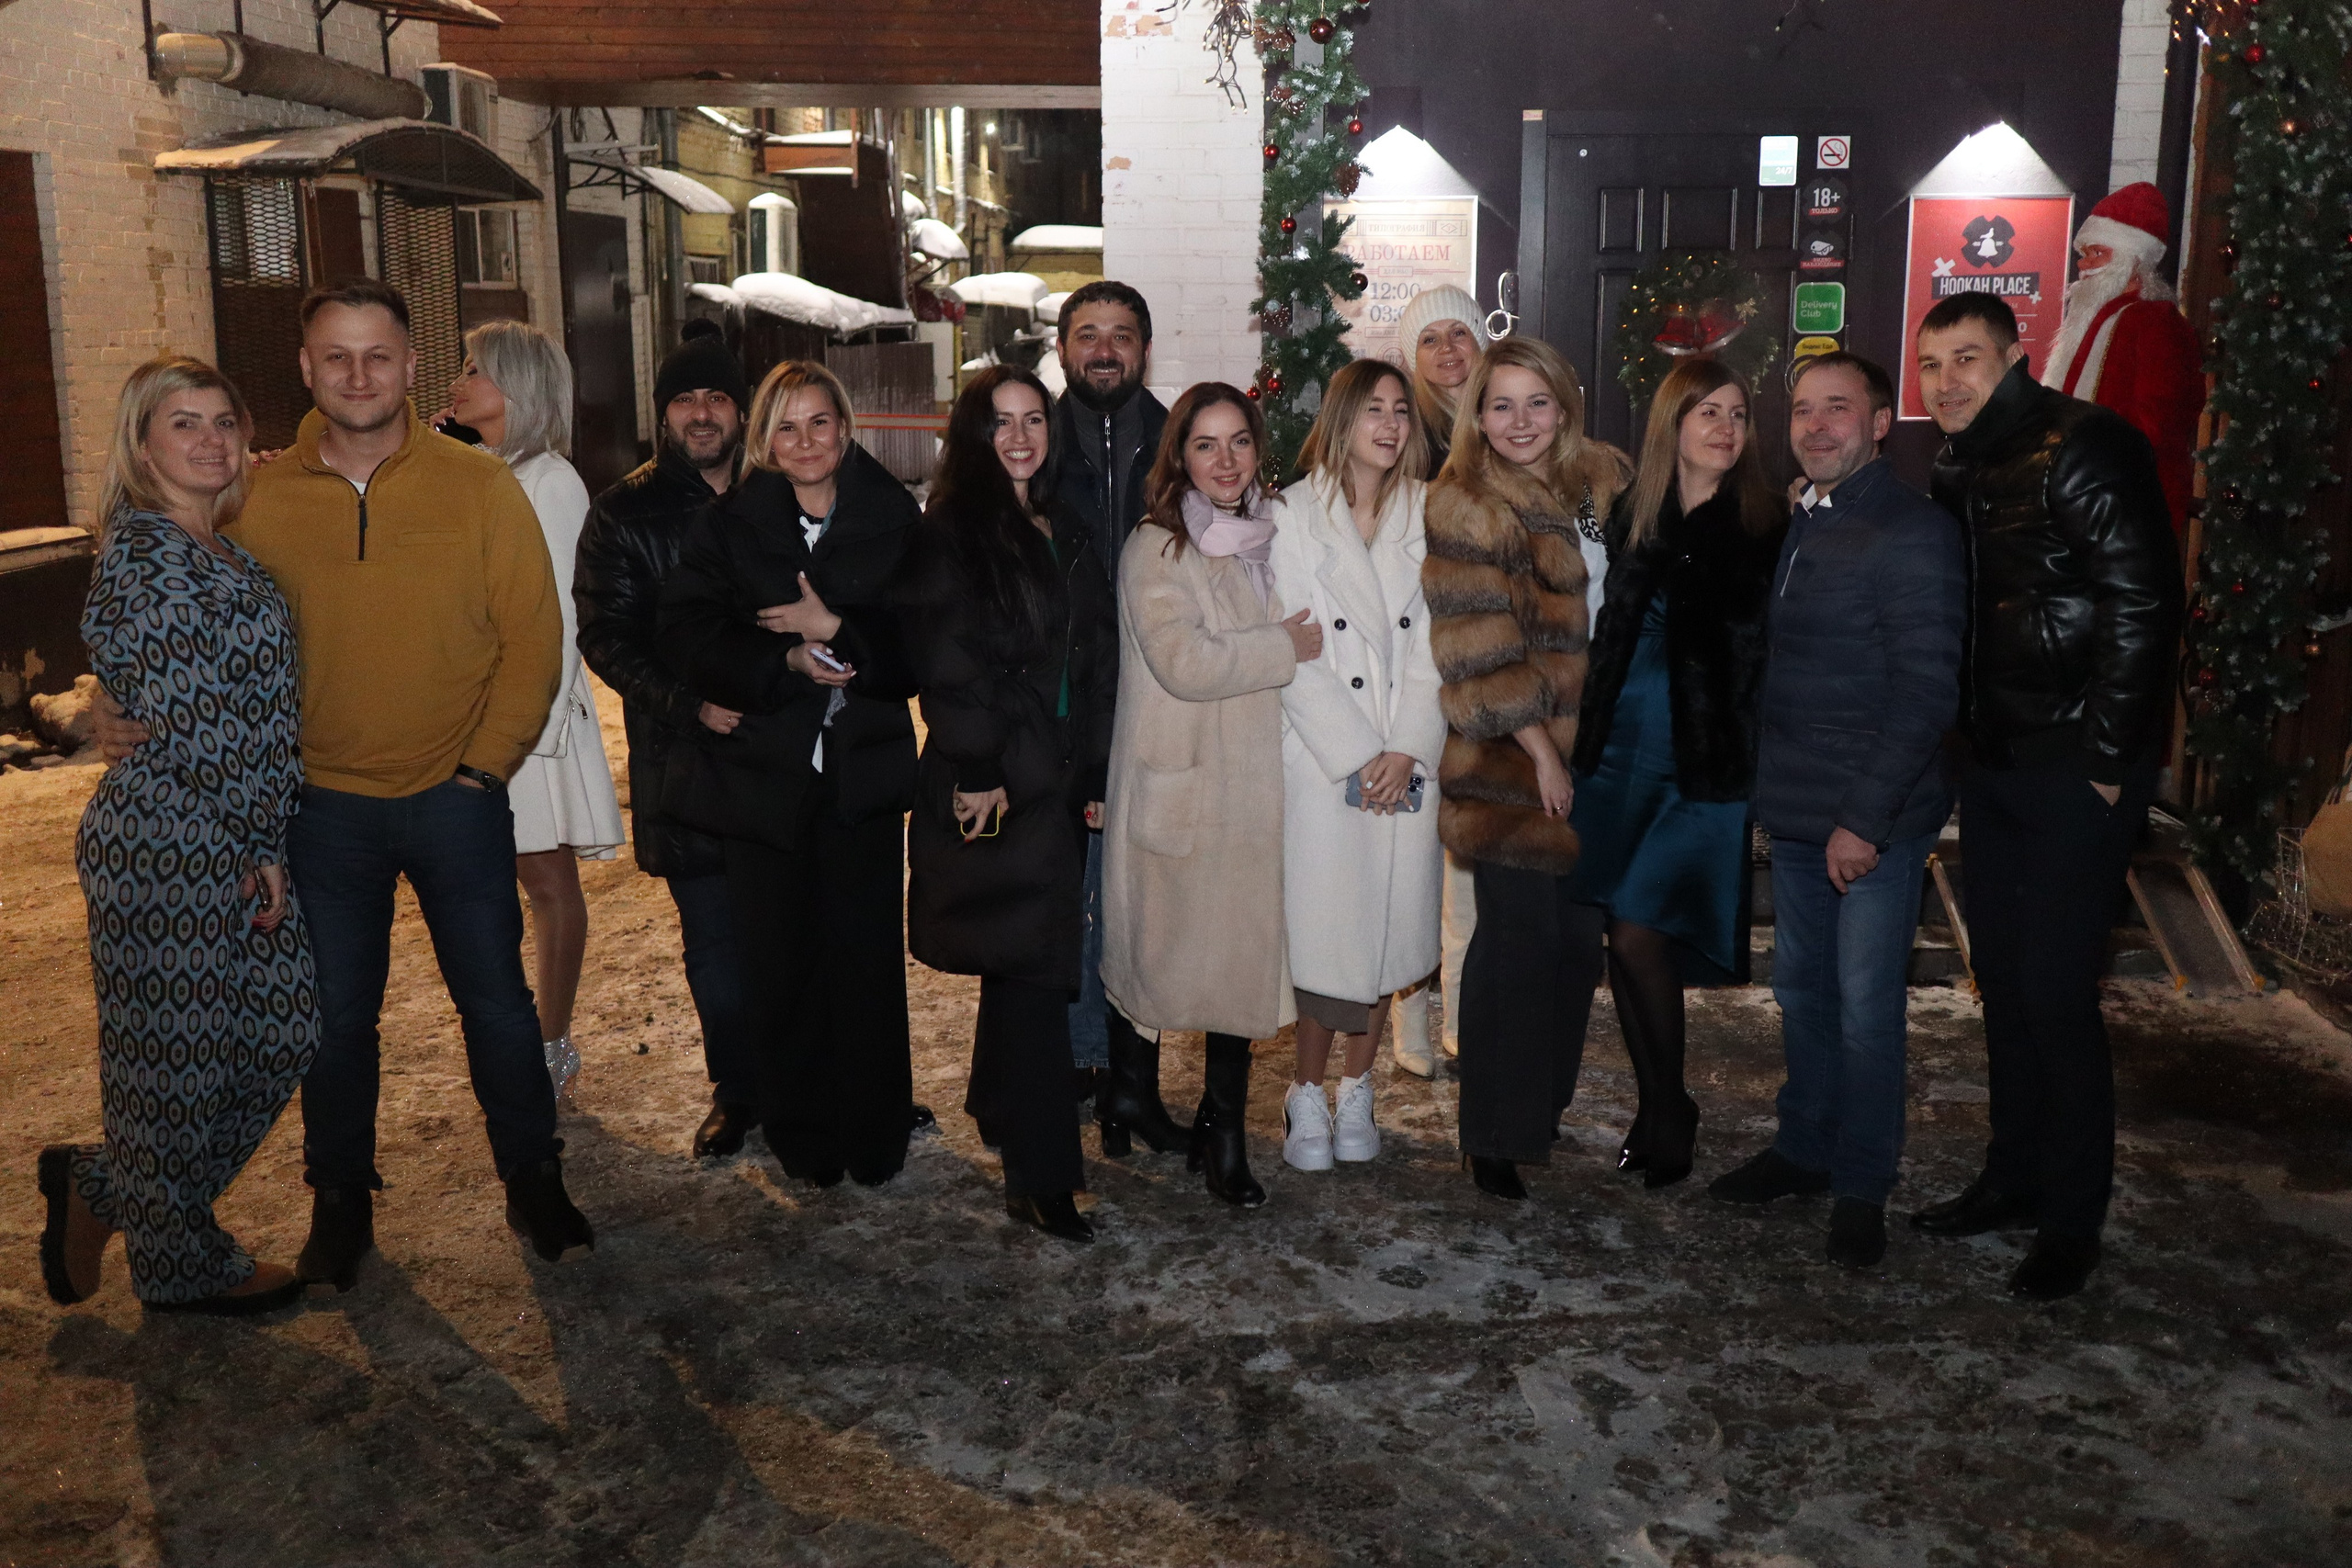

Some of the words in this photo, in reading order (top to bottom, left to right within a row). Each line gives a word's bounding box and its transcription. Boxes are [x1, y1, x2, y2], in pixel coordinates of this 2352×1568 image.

[1813, 187, 1841, 208] 18+
[1345, 244, 1451, 261] РАБОТАЕМ
[1370, 282, 1421, 300] 12:00
[1940, 276, 1990, 295] HOOKAH
[1993, 276, 2031, 294] PLACE
[1801, 300, 1838, 310] Delivery
